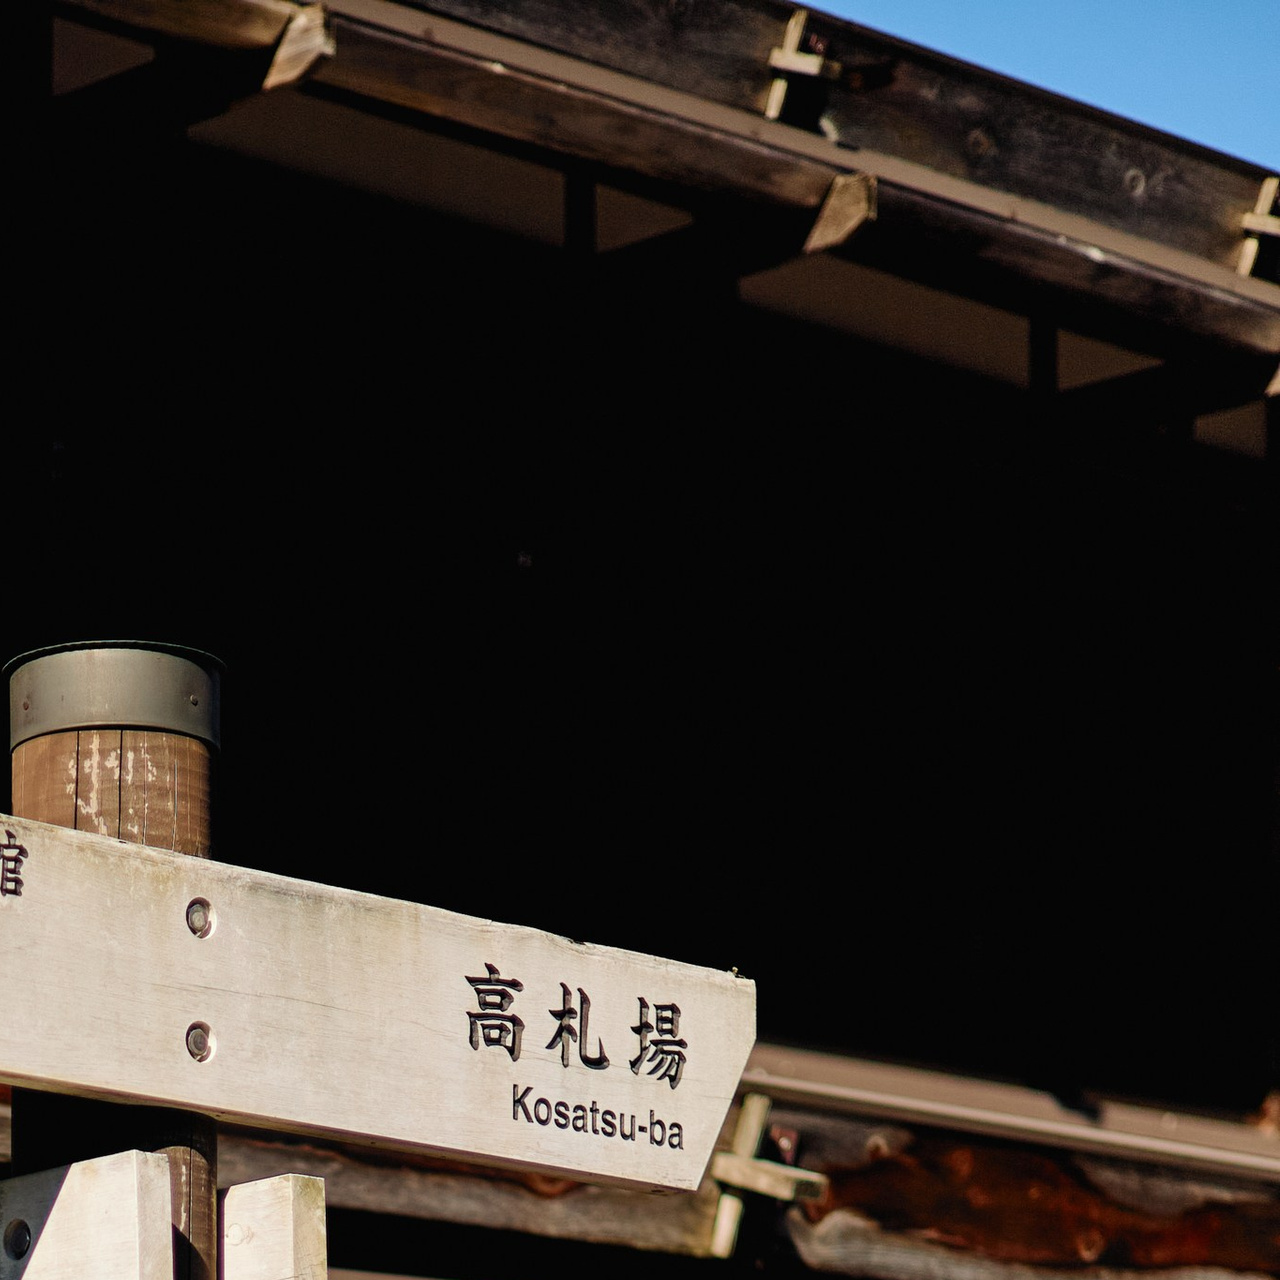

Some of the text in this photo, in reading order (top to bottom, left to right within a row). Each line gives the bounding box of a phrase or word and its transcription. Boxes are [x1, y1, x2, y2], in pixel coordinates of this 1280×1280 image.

[464, 962, 688, 1090] 高札場
[511, 1083, 685, 1150] Kosatsu-ba
